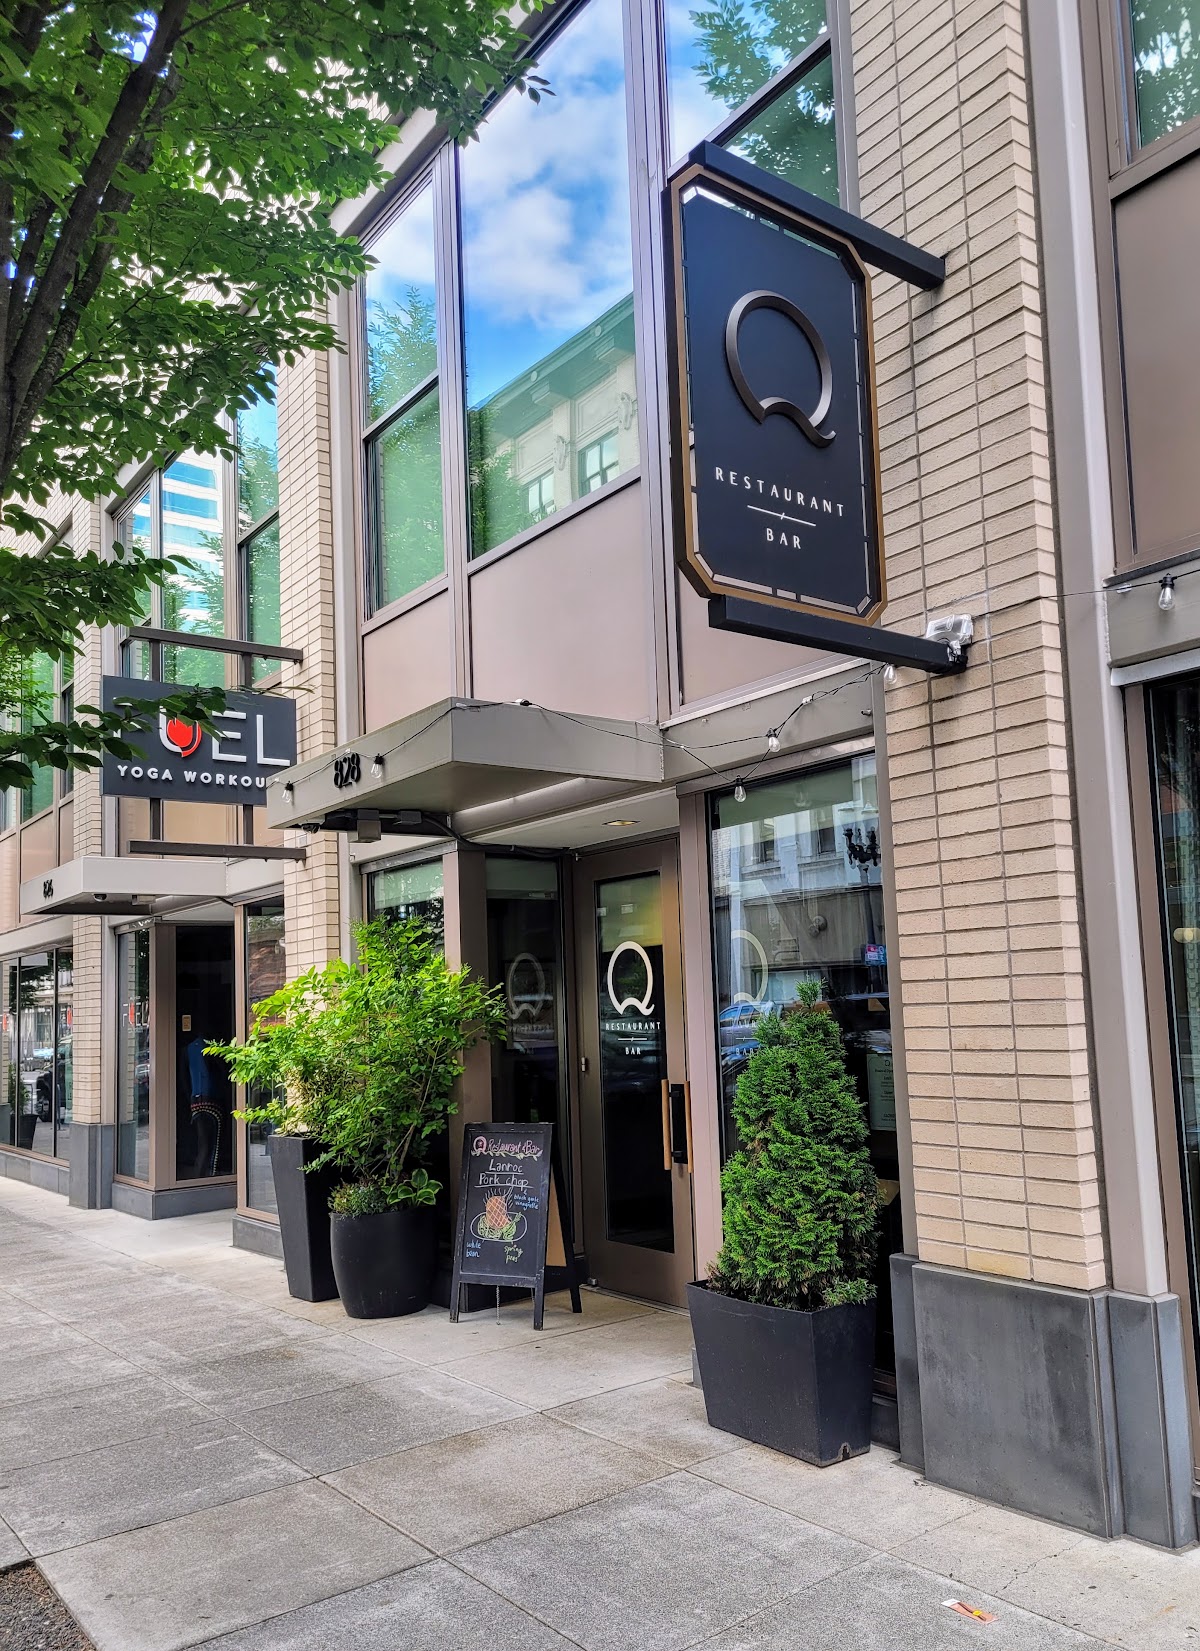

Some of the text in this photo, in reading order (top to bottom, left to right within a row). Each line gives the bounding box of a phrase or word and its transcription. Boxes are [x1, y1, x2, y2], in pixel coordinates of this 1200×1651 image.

[726, 290, 836, 448] Q
[715, 466, 844, 516] RESTAURANT
[766, 527, 801, 549] BAR
[117, 764, 173, 781] YOGA
[334, 752, 361, 788] 828
[607, 940, 655, 1016] Q
[605, 1021, 661, 1031] RESTAURANT
[625, 1046, 641, 1055] BAR
[487, 1138, 521, 1154] Restaurant
[525, 1140, 540, 1154] Bar
[479, 1173, 529, 1192] Pork chop
